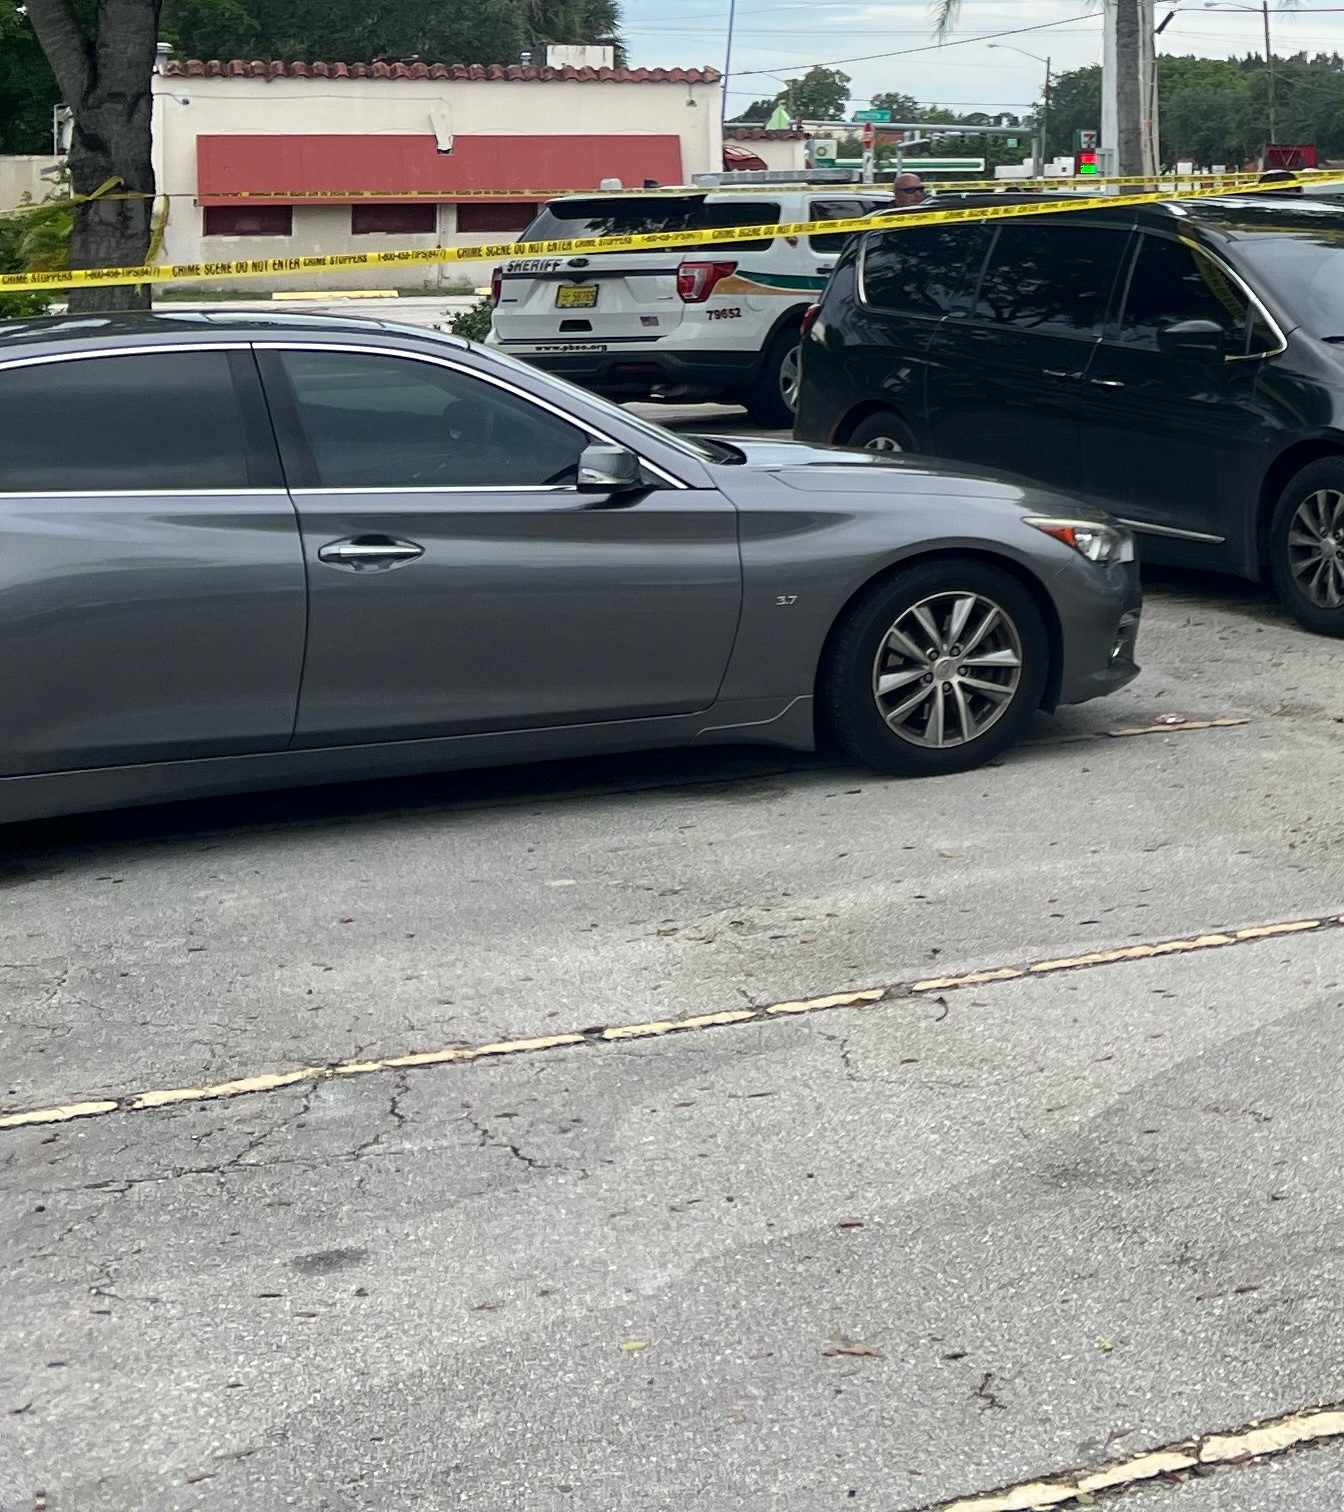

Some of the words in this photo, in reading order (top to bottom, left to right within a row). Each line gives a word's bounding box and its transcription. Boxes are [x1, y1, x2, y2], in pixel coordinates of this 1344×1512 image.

[172, 264, 200, 277] CRIME
[204, 262, 232, 275] SCENE
[236, 261, 248, 273] DO
[252, 260, 269, 272] NOT
[272, 258, 300, 271] ENTER
[507, 259, 563, 272] SHERIFF
